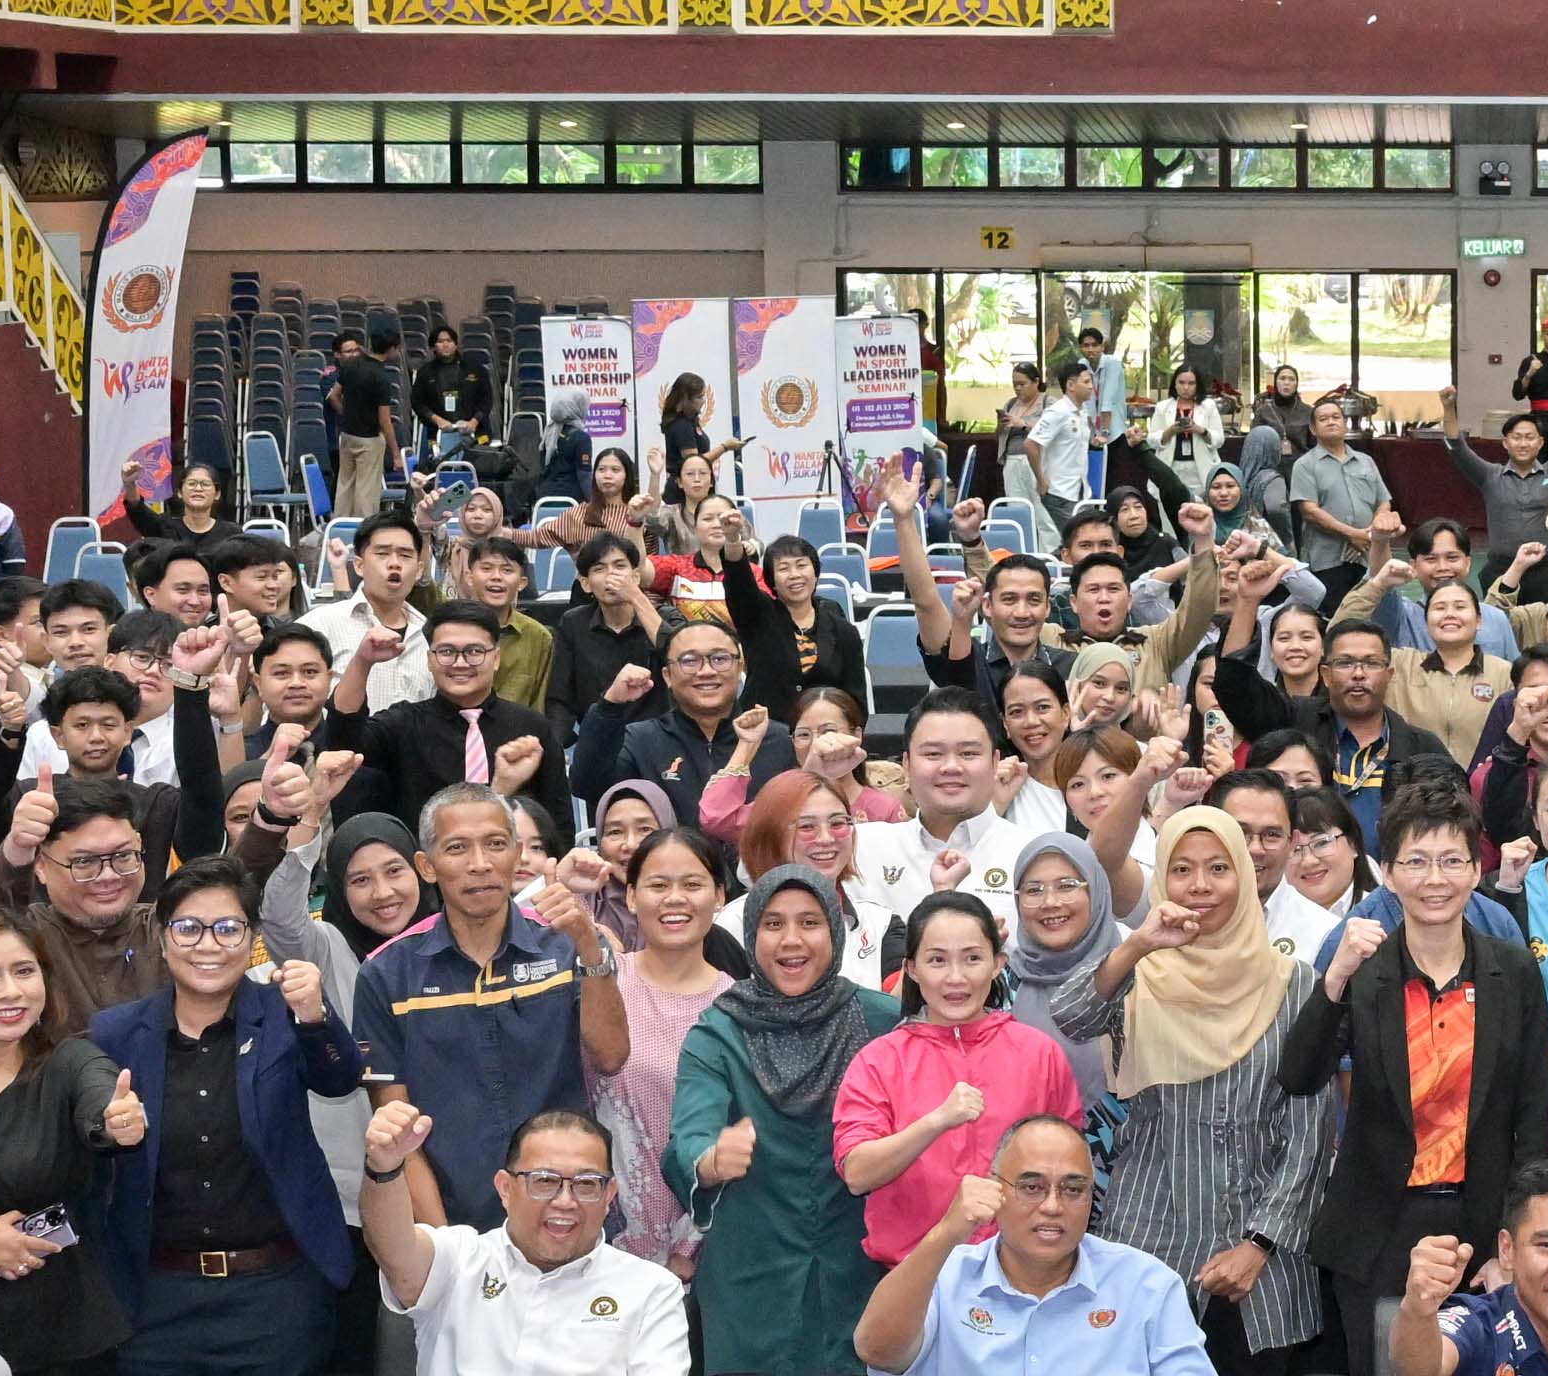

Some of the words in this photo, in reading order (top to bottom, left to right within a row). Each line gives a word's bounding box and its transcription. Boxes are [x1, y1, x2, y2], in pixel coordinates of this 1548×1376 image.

[984, 232, 1009, 249] 12
[1463, 240, 1512, 255] KELUAR
[562, 348, 618, 360] WOMEN
[854, 344, 906, 357] WOMEN
[564, 364, 577, 372] IN
[580, 363, 619, 372] SPORT
[856, 360, 868, 369] IN
[872, 358, 908, 368] SPORT
[551, 373, 631, 385] LEADERSHIP
[844, 368, 919, 382] LEADERSHIP
[857, 383, 906, 393] SEMINAR
[1506, 1310, 1527, 1350] IMPACT
